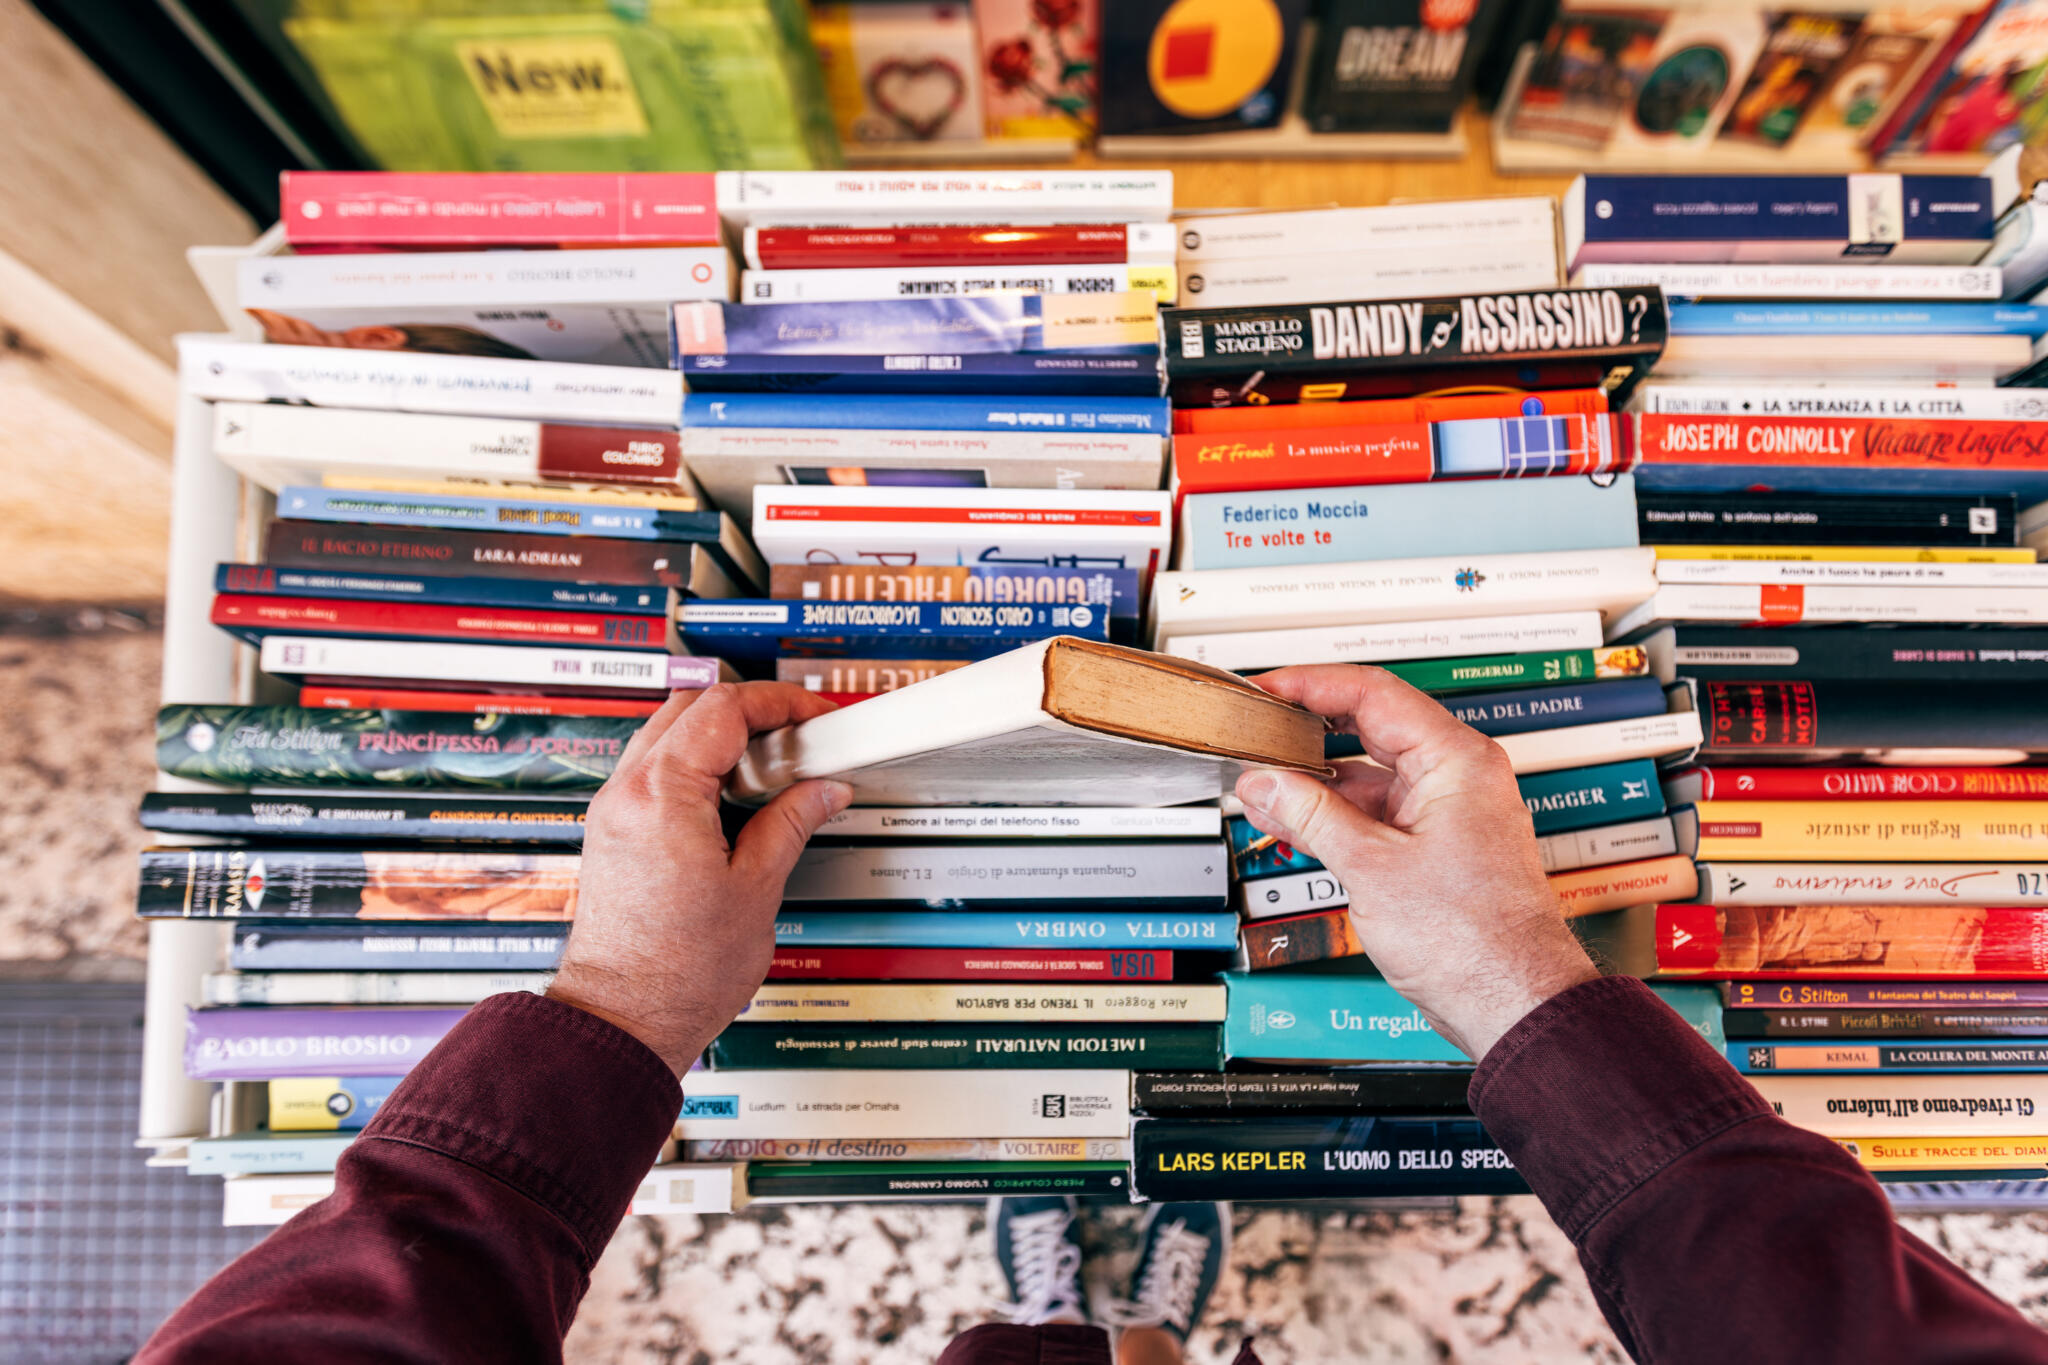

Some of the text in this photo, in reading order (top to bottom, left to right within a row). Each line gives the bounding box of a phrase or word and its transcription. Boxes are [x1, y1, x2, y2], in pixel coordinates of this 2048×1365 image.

[1336, 26, 1465, 79] DREAM
[898, 278, 1114, 294] GORDON SCIAMANO
[1215, 319, 1302, 336] MARCELLO
[1309, 302, 1424, 360] DANDY
[1215, 335, 1303, 355] STAGLIENO
[1035, 360, 1085, 368] COSTANZO
[1763, 400, 1781, 411] LA
[1789, 399, 1871, 413] SPERANZA
[1894, 401, 1913, 412] LA
[1071, 412, 1151, 428] Massimo Fini
[1288, 437, 1420, 459] La musica perfetta
[1660, 423, 1739, 452] JOSEPH
[1749, 425, 1855, 453] CONNOLLY
[1864, 424, 1952, 461] Vacanze
[969, 511, 1076, 521] PAURA CINQUANTA
[1223, 500, 1368, 523] Federico Moccia
[1646, 511, 1715, 522] Edmund White
[1225, 528, 1332, 548] Tre volte te
[473, 548, 512, 565] LARA
[514, 550, 582, 567] ADRIAN
[227, 566, 274, 590] USA
[1780, 567, 1814, 576] Anche
[964, 575, 1085, 602] GIORGIO
[1249, 567, 1600, 594] GIOVANNI PAOLO VARCARE SOGLIA DELLA SPERANZA
[803, 605, 1033, 625] CARLO SGORLON CARROZZA RAME
[603, 620, 647, 643] USA
[1452, 663, 1524, 681] FITZGERALD
[1493, 696, 1584, 719] DEL PADRE
[529, 737, 620, 756] FORESTE
[1890, 774, 1956, 794] CUORE
[1526, 787, 1607, 814] DAGGER
[334, 809, 392, 821] AVVENTURE
[431, 810, 507, 825] D'ARGENTO
[882, 816, 1080, 829] L'amore ai tempi del telefono fisso
[1710, 820, 2032, 839] Dunn Regina di astuzie CORBACCIO
[870, 865, 1136, 879] Cinquanta sfumature di Grigio James
[223, 851, 247, 917] RAMSES
[1559, 873, 1668, 901] ANTONIA ARSLAN
[1772, 877, 1892, 893] andiamo
[1016, 921, 1215, 937] RIOTTA OMBRA
[964, 953, 1155, 977] USA STORIA, SOCIETÀ PERSONAGGI D'AMERICA
[802, 999, 850, 1007] FELTRINELLI
[956, 998, 1009, 1008] BABYLON
[1014, 998, 1036, 1008] PER
[1041, 998, 1078, 1008] TRENO
[1083, 998, 1093, 1008] IL
[1105, 996, 1156, 1009] Roggero
[1741, 986, 2016, 1003] 10 G. Stilton fantasma del Teatro dei Sospiri
[1161, 998, 1187, 1009] Alex
[1330, 1010, 1363, 1030] Un
[1801, 1018, 1829, 1027] STINE
[203, 1036, 412, 1059] PAOLO BROSIO
[776, 1037, 1136, 1052] METODI NATURALI centro studi pavese sessuologia
[1826, 1050, 2033, 1063] KEMAL LA COLLERA DEL MONTE
[1152, 1084, 1184, 1092] POIROT
[749, 1102, 899, 1113] Ludlum La strada per Omaha
[1827, 1098, 2034, 1117] Ci rivedremo all'inferno
[785, 1143, 800, 1156] o
[806, 1140, 819, 1156] il
[824, 1139, 906, 1156] destino
[1004, 1141, 1080, 1155] VOLTAIRE
[1924, 1147, 2008, 1156] TRACCE DEL
[1158, 1151, 1453, 1172] LARS KEPLER L'UOMO DELLO
[889, 1178, 1085, 1189] PIERO COLAPRICO L'UOMO CANNONE
